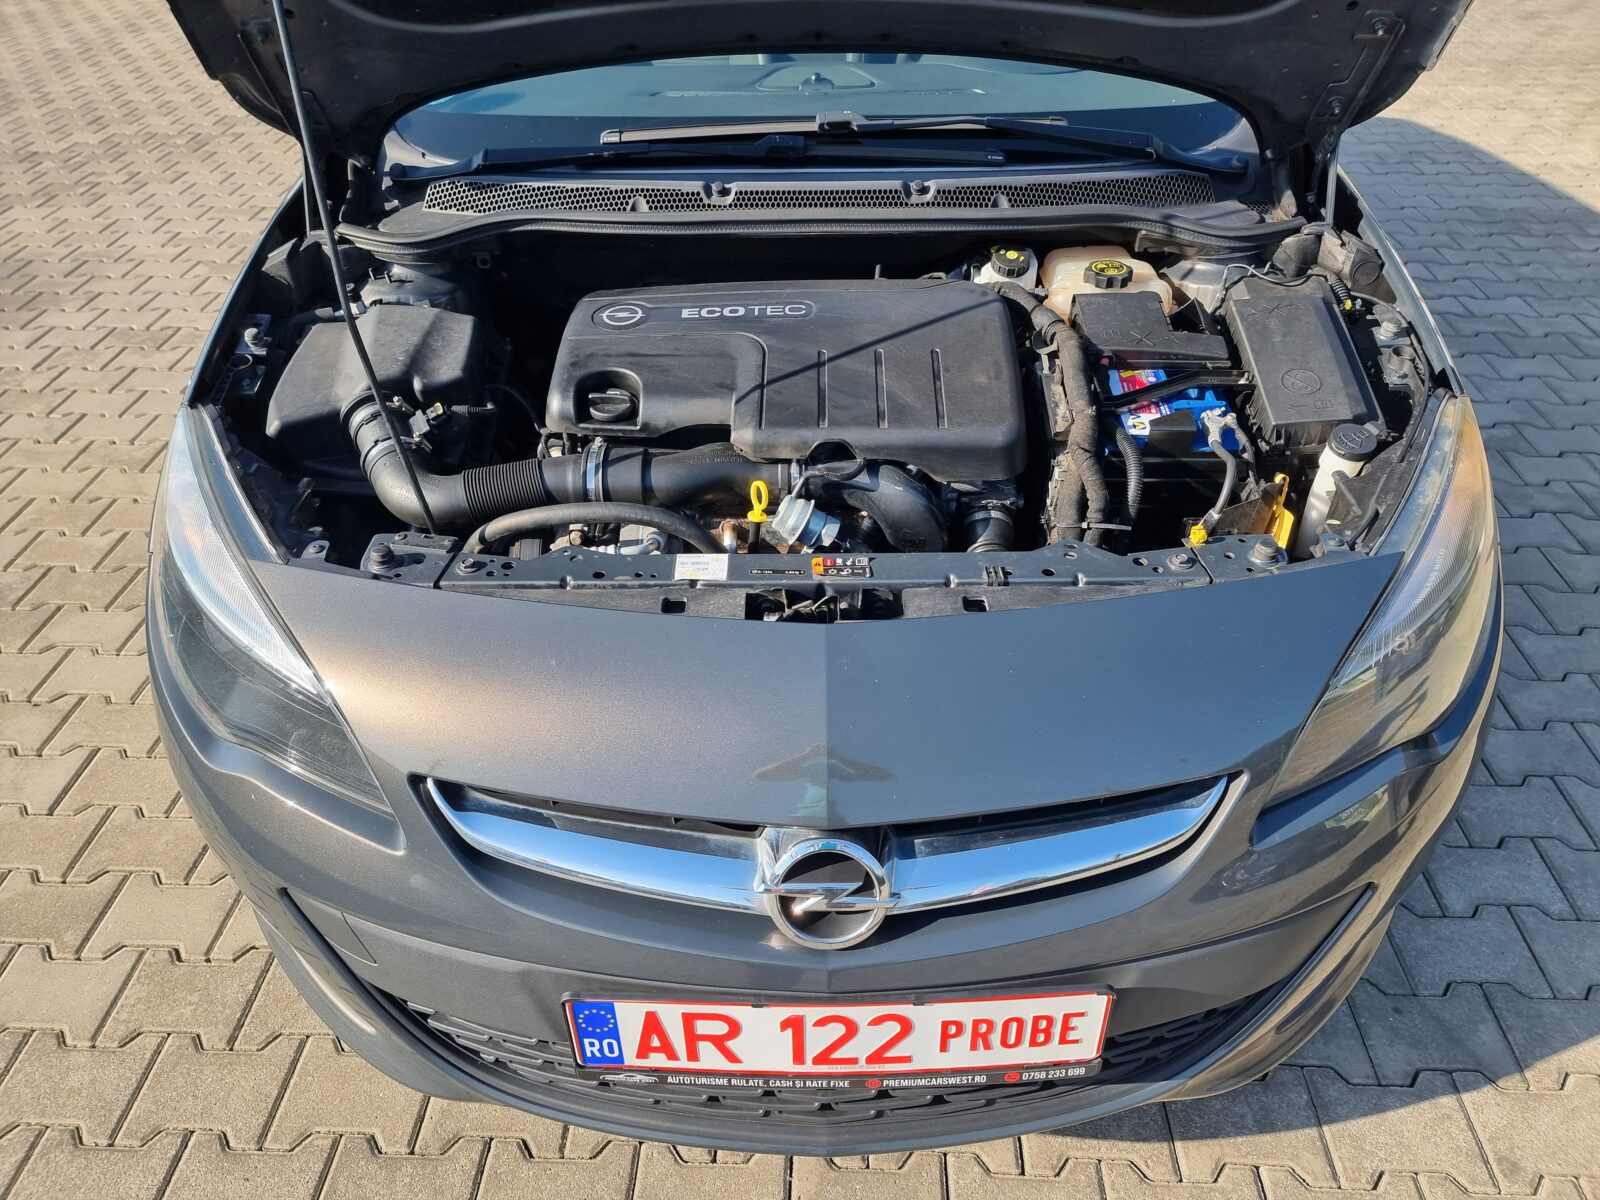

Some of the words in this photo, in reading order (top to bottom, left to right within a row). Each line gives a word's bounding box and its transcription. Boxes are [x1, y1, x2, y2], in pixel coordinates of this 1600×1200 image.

[681, 304, 807, 319] ECOTEC
[635, 1010, 741, 1064] AR
[779, 1012, 913, 1066] 122
[939, 1011, 1088, 1053] PROBE
[583, 1038, 620, 1058] RO
[882, 1074, 987, 1087] PREMIUMCARSWEST.RO
[1022, 1070, 1046, 1081] 0758
[1047, 1069, 1066, 1079] 233
[1067, 1066, 1086, 1077] 699
[667, 1075, 729, 1086] AUTOTURISME
[730, 1078, 767, 1087] RULATE,
[769, 1079, 793, 1087] CASH
[805, 1080, 829, 1088] RATE
[830, 1080, 850, 1088] FIXE
